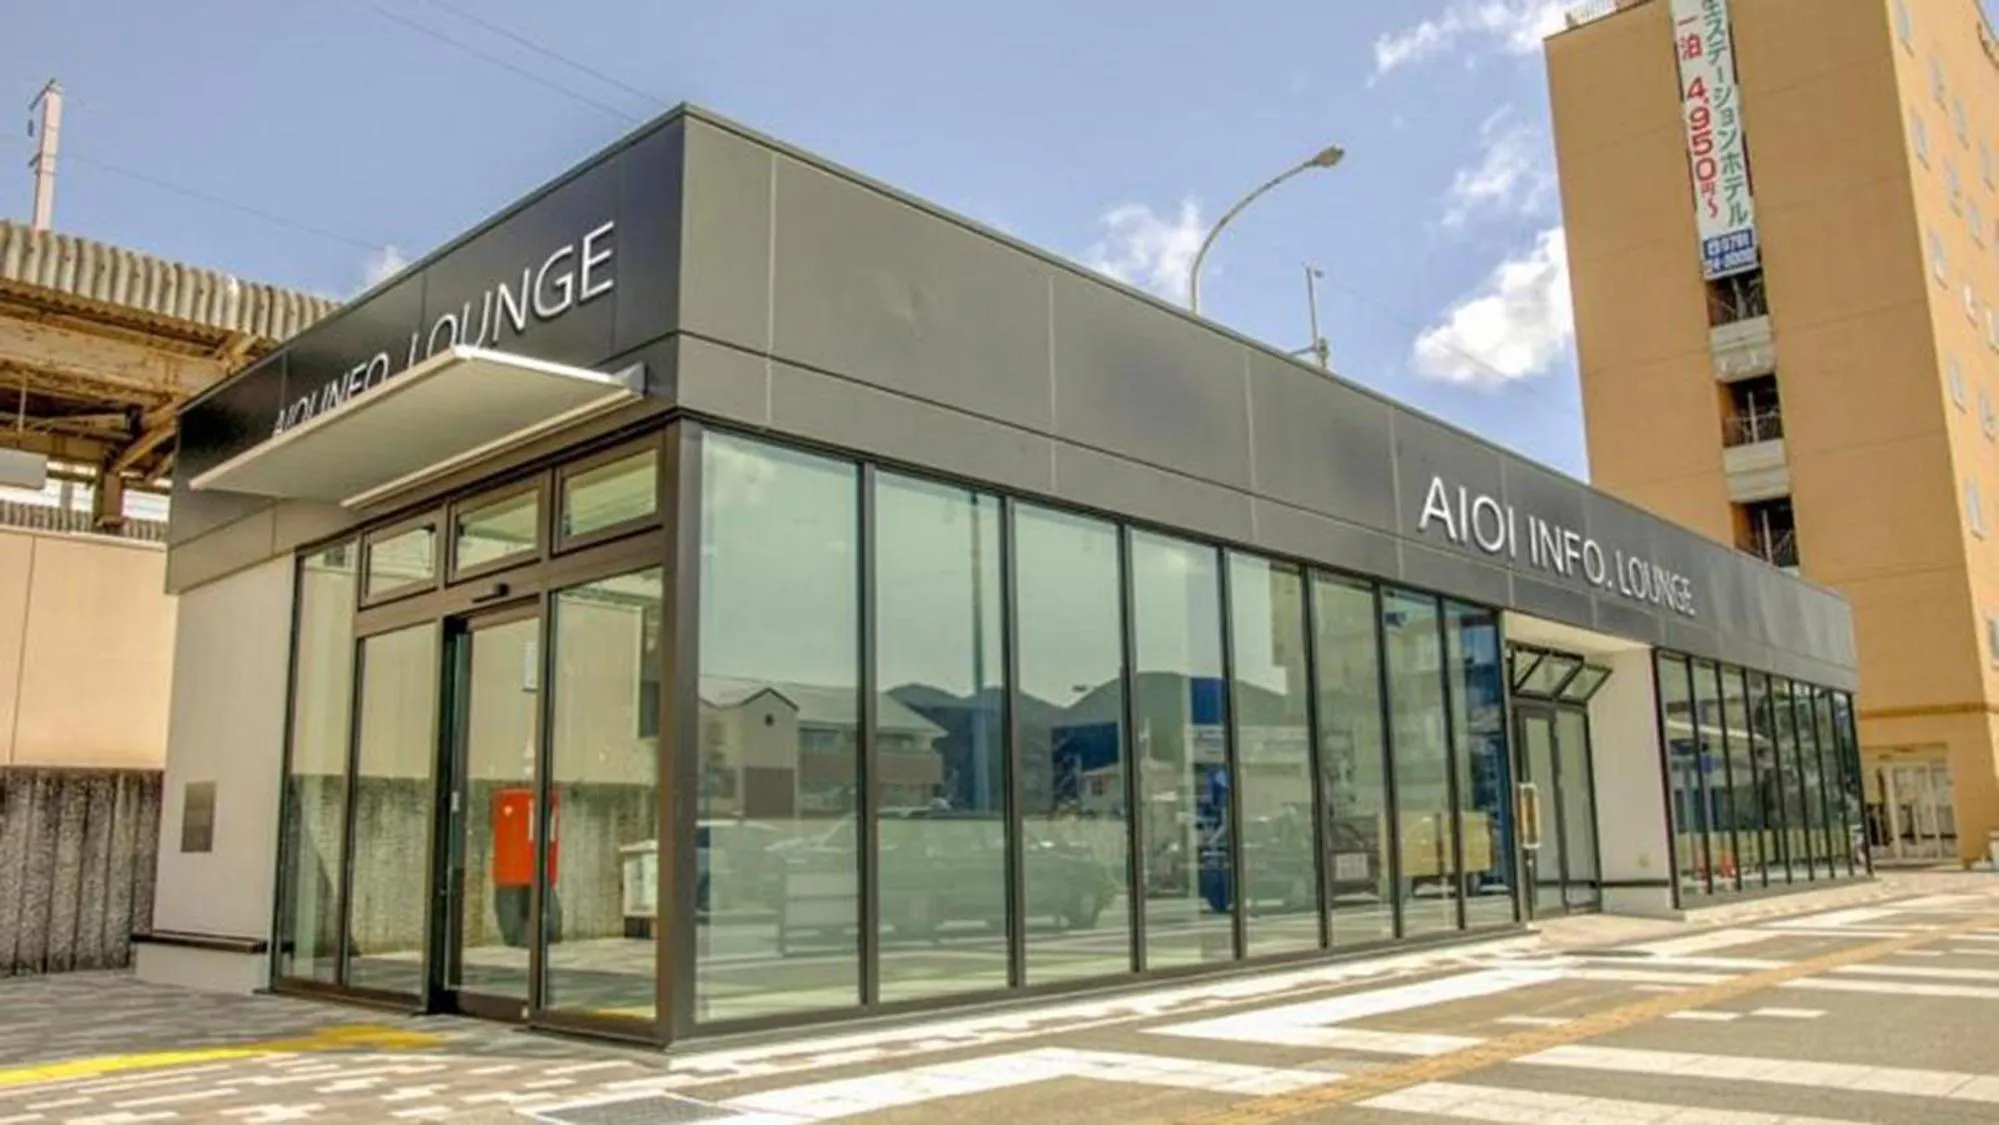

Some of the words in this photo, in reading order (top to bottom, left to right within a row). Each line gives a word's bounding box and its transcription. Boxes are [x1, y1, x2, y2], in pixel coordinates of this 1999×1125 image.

[1418, 475, 1516, 558] AIOI
[1528, 515, 1613, 589] INFO.
[1615, 549, 1696, 616] LOUNGE
